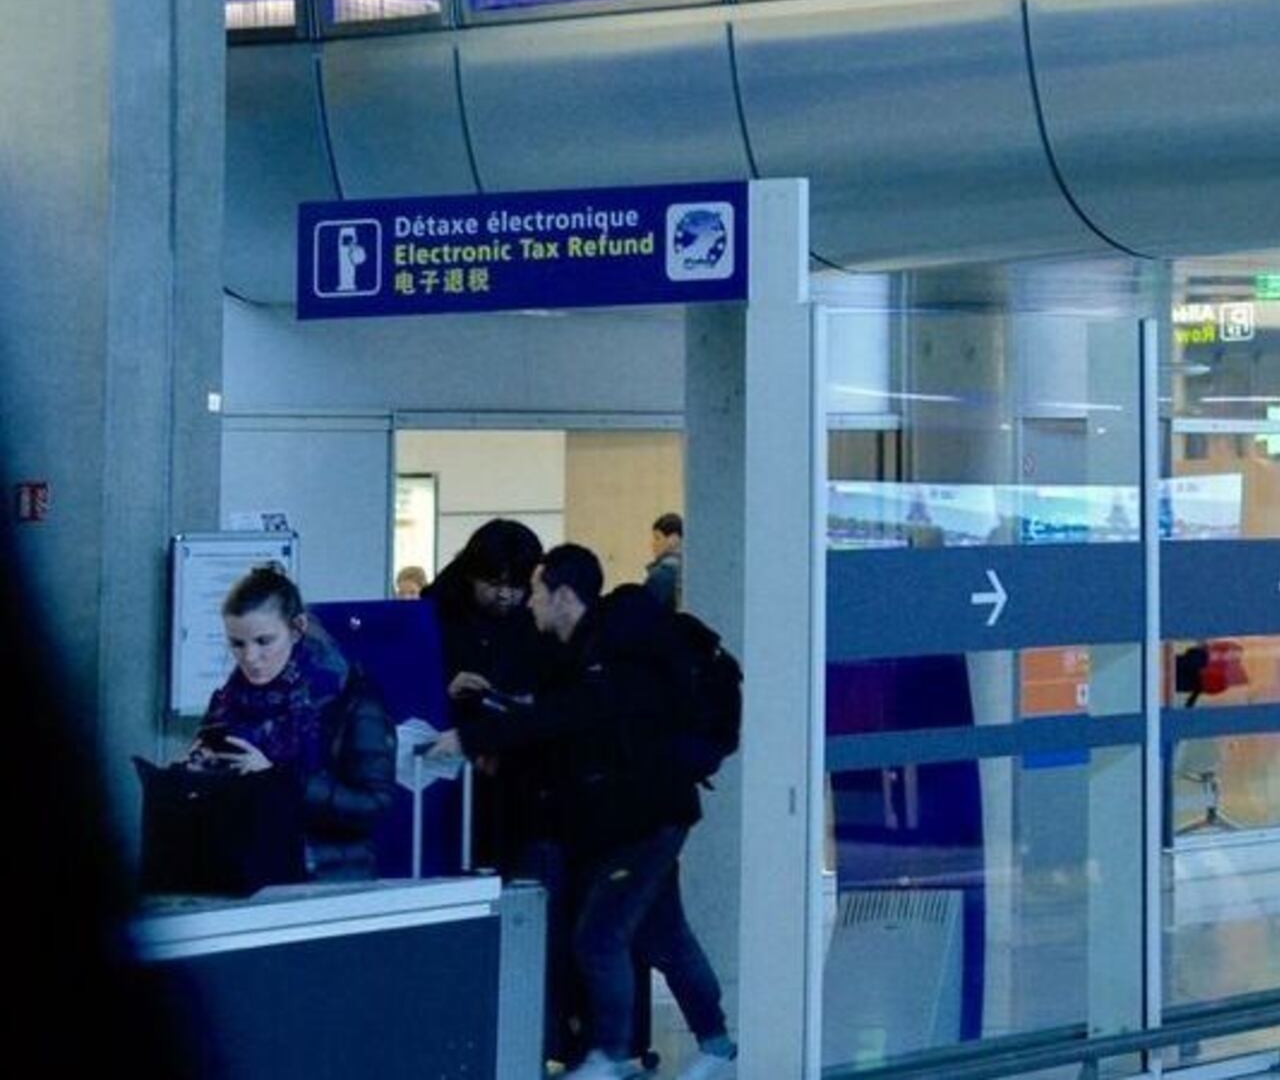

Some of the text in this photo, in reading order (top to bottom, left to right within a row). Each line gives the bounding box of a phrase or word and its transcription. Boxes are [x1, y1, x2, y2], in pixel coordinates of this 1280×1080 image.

[395, 207, 639, 238] Détaxe électronique
[395, 233, 655, 264] Electronic Tax Refund
[395, 267, 490, 294] 电子退税
